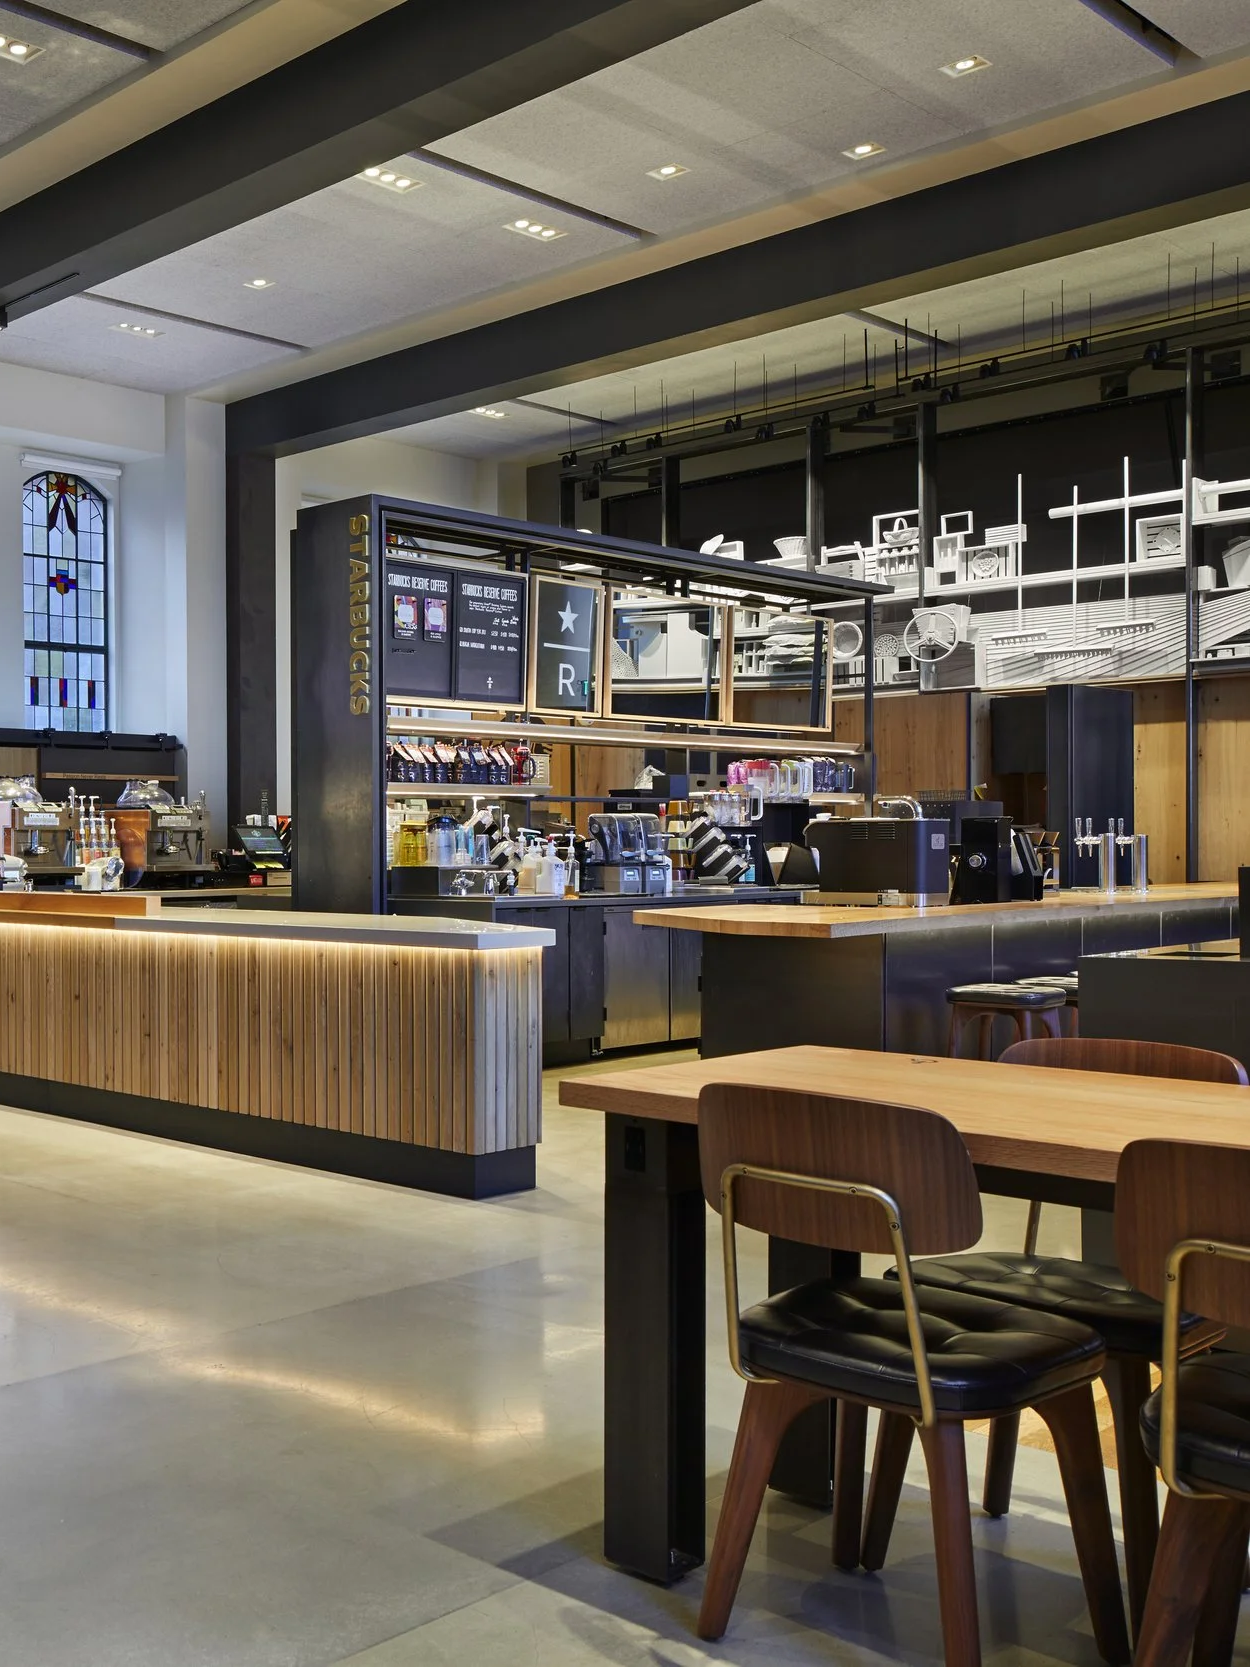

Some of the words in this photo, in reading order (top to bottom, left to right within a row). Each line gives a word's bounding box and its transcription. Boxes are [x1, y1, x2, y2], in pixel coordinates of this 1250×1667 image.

[387, 573, 411, 588] STARBUCKS
[411, 576, 430, 591] RESERVE
[430, 578, 448, 593] COFFEES
[461, 583, 483, 598] STARBUCKS
[483, 586, 500, 600] RESERVE
[500, 588, 518, 602] COFFEES
[349, 514, 371, 716] STARBUCKS
[558, 663, 576, 697] R
